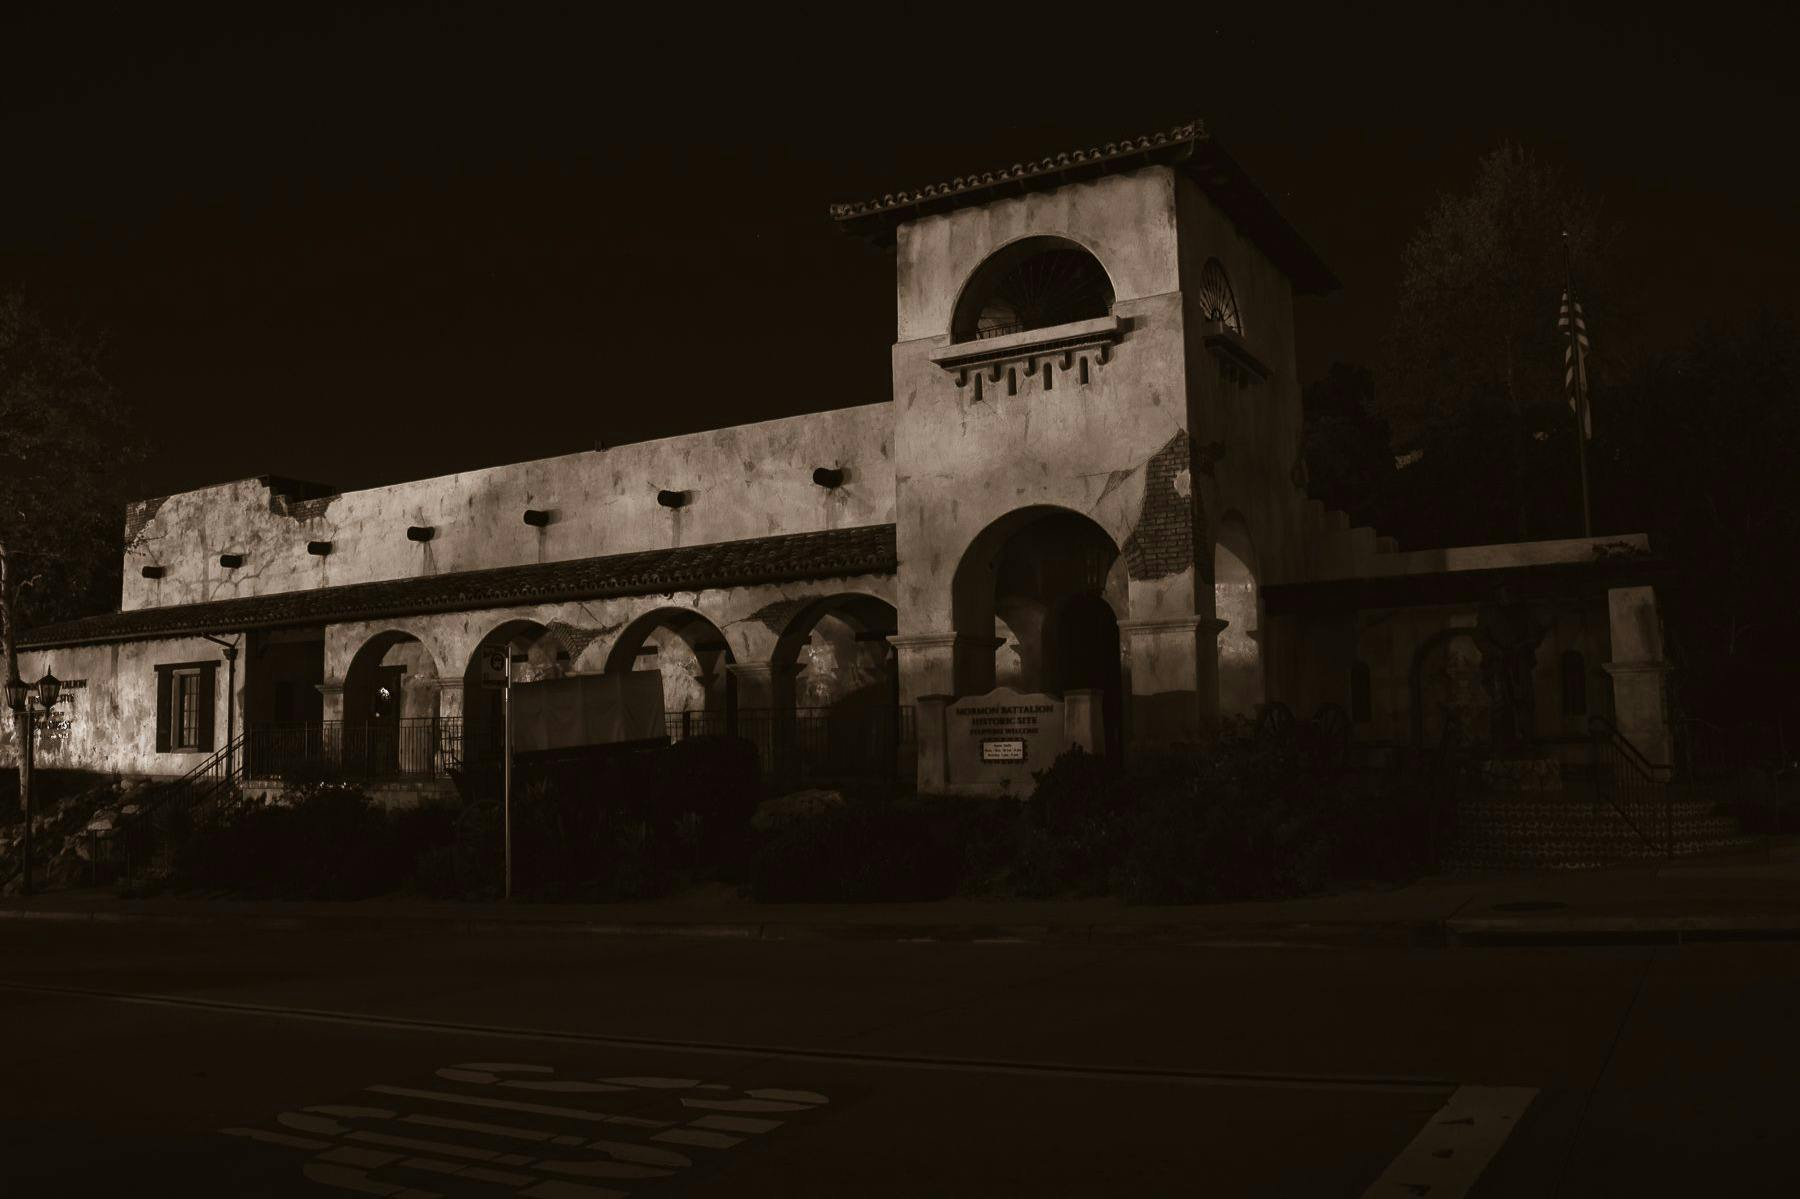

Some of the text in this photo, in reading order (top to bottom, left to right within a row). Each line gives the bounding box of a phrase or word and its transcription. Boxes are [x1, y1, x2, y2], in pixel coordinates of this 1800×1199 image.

[956, 705, 1053, 715] MORMON BATTALION
[972, 716, 1037, 725] HISTORIC SITE
